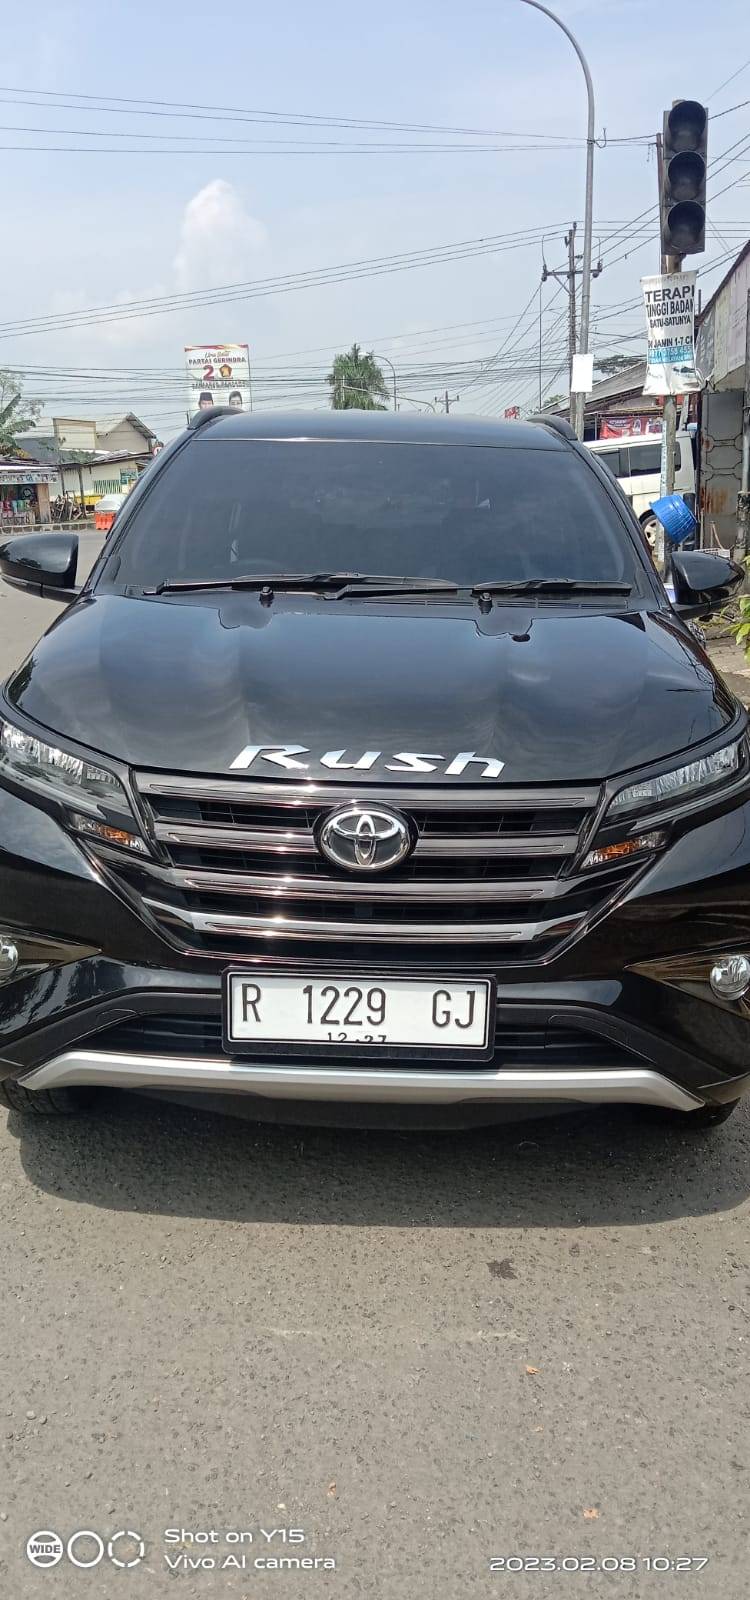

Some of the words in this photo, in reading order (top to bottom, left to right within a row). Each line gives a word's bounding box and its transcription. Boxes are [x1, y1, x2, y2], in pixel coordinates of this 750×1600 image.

[645, 285, 695, 303] TERAPI
[646, 302, 668, 318] TINGGI
[650, 315, 691, 328] SATU-SATUNYA
[654, 337, 673, 348] JAMIN
[674, 336, 684, 346] 1-7
[203, 365, 214, 381] 2
[229, 744, 506, 779] Rush
[241, 983, 262, 1023] R
[303, 985, 387, 1026] 1229
[431, 989, 476, 1029] GJ
